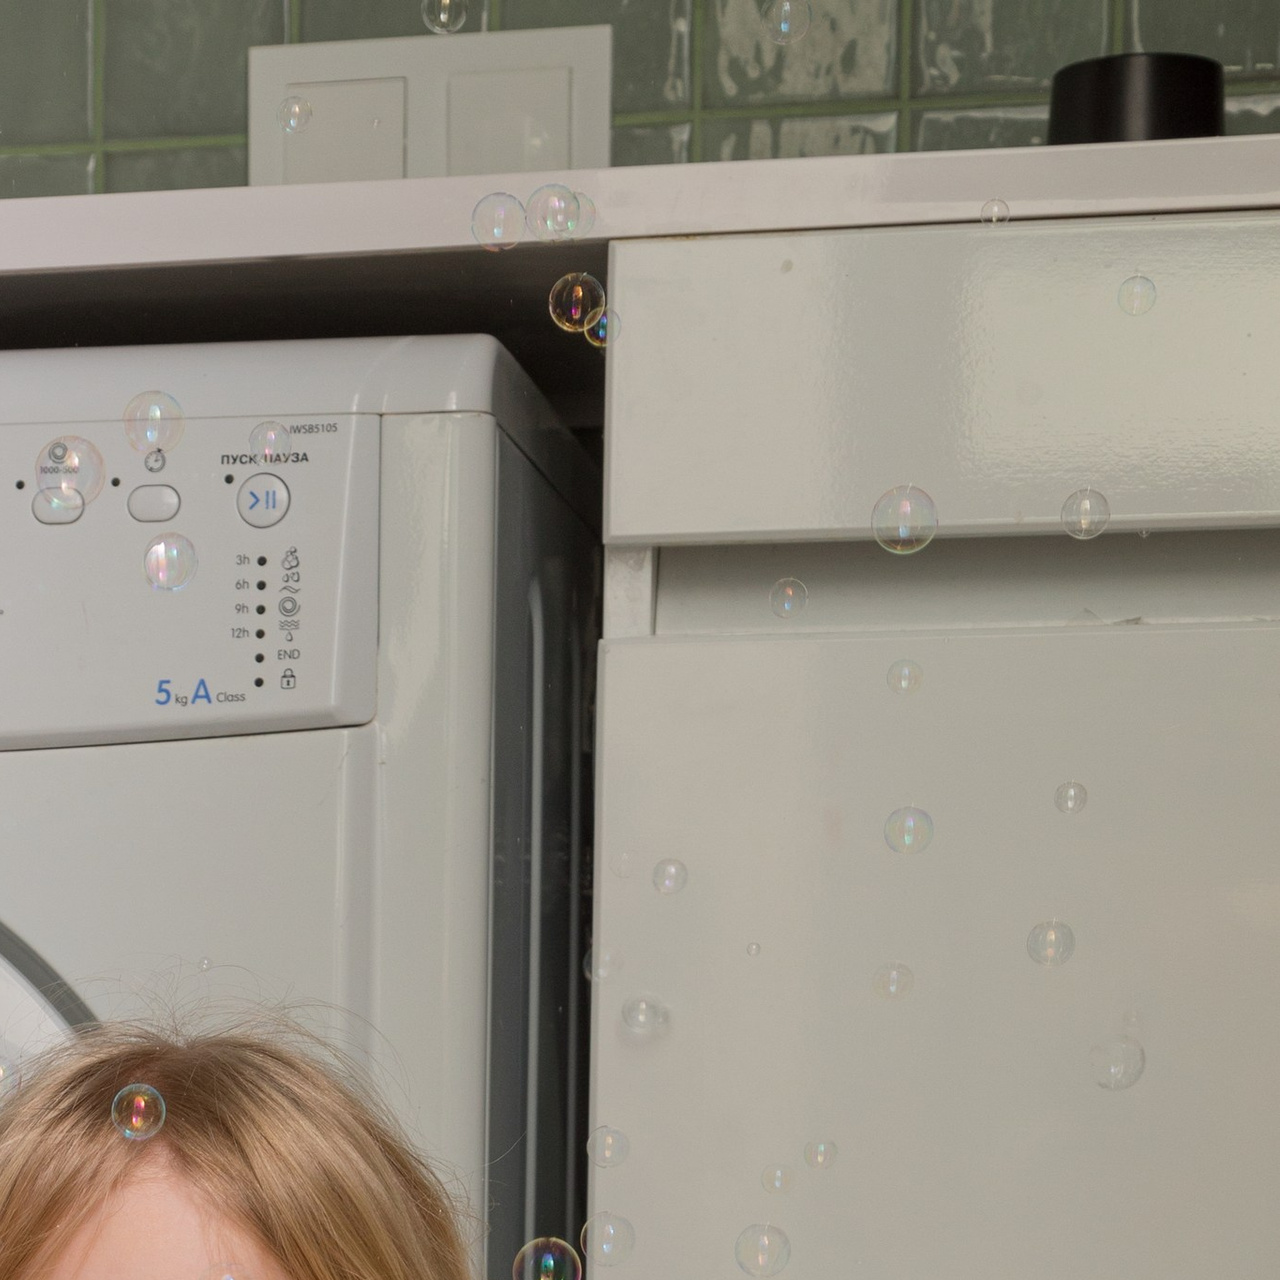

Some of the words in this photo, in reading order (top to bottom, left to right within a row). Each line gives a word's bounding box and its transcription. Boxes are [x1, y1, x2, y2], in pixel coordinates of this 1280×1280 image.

[290, 423, 338, 435] IWSB5105
[236, 555, 250, 566] 3h
[235, 580, 250, 591] 6h
[234, 604, 249, 615] 9h
[230, 627, 250, 639] 12h
[277, 650, 301, 661] END
[154, 680, 171, 705] 5
[175, 694, 188, 707] kg
[191, 678, 212, 705] A
[216, 691, 246, 703] Class
